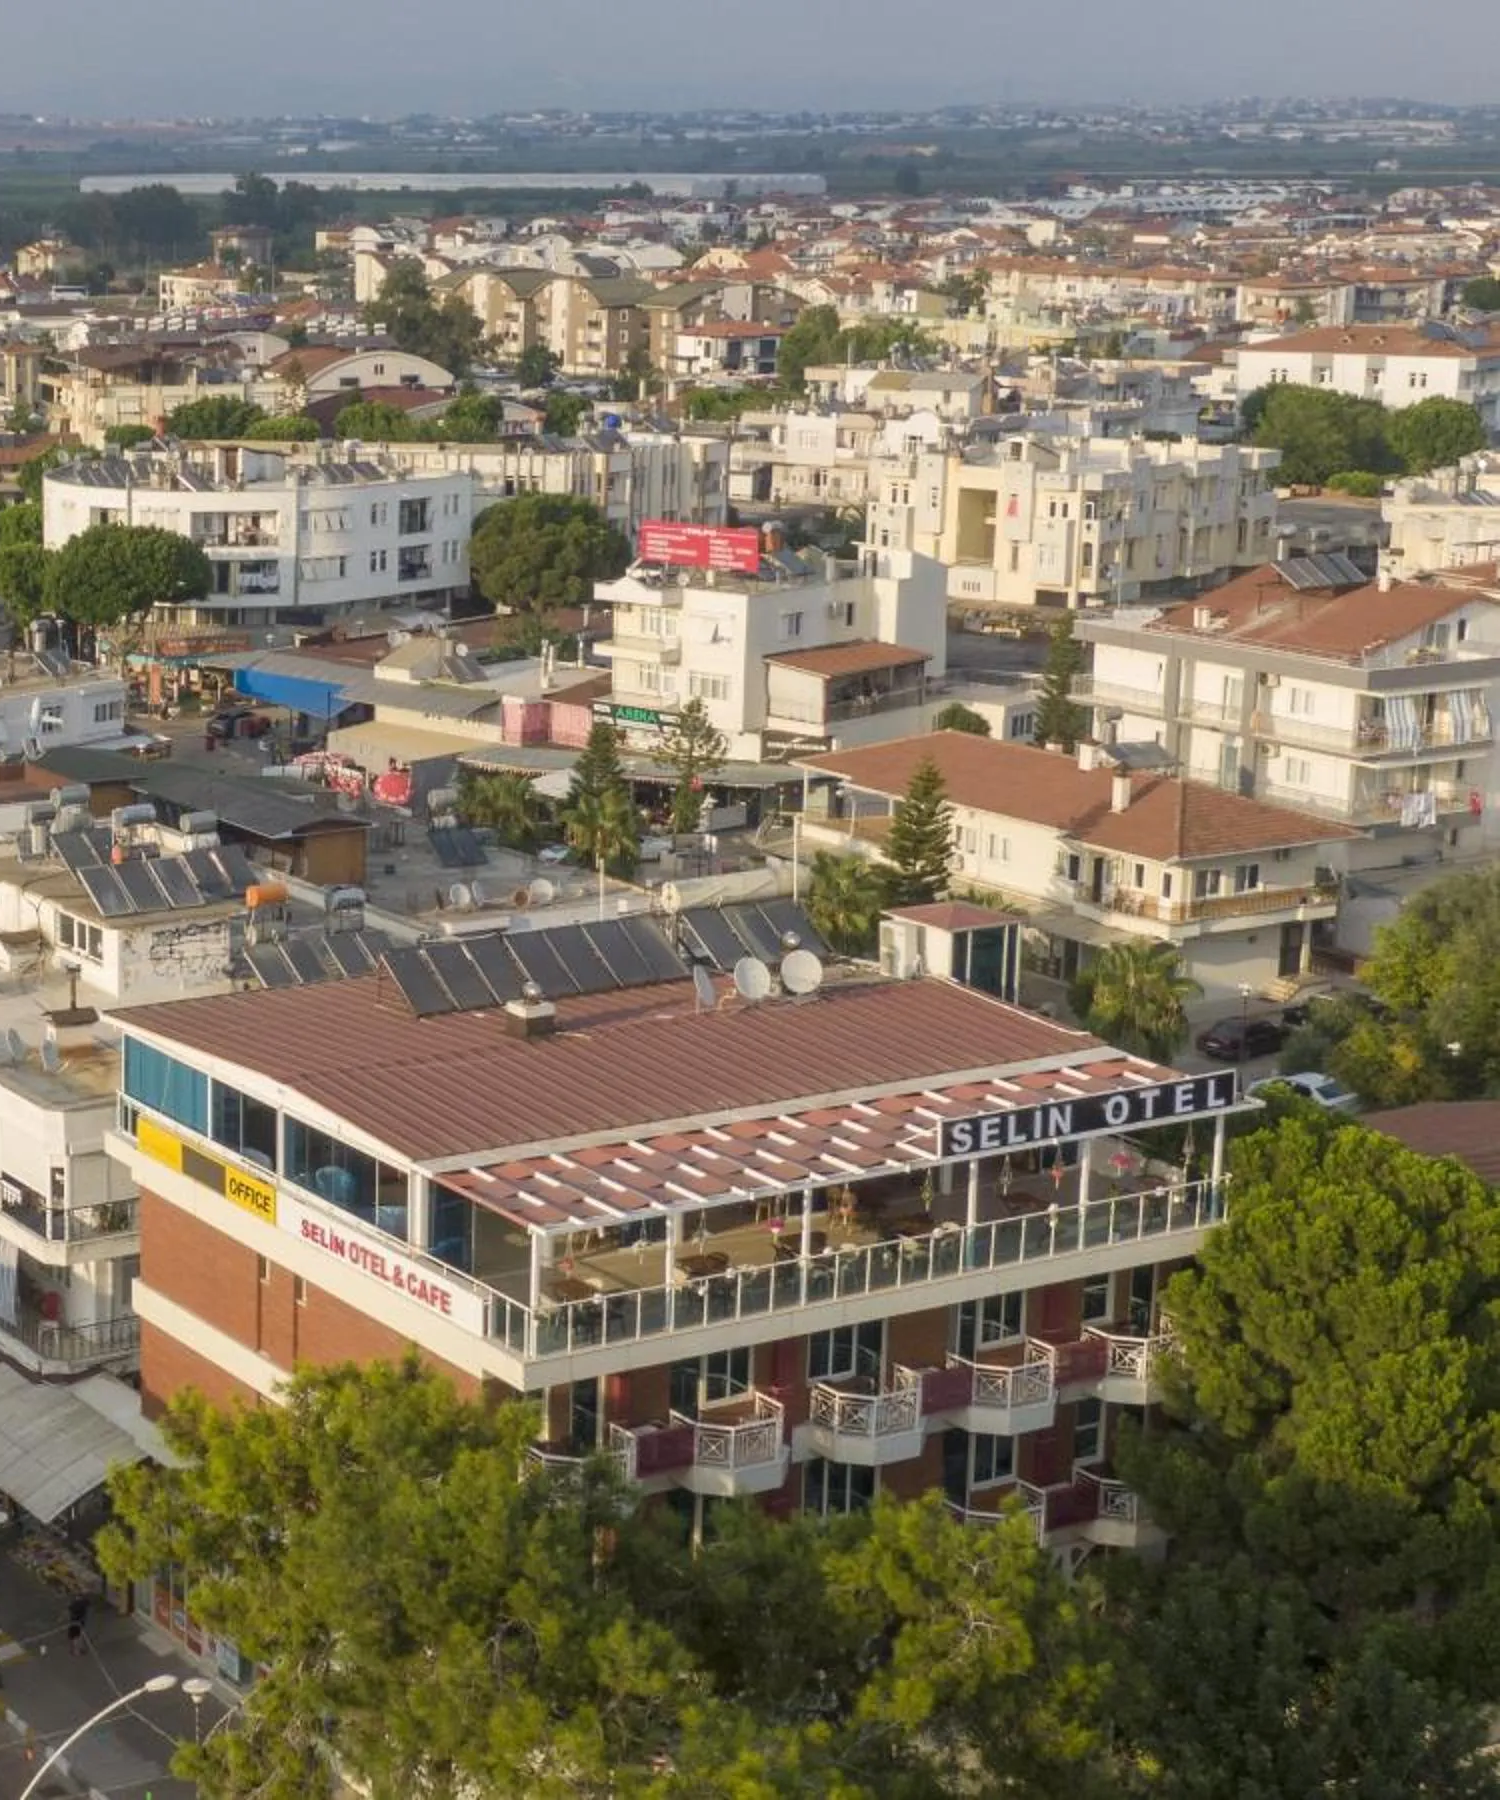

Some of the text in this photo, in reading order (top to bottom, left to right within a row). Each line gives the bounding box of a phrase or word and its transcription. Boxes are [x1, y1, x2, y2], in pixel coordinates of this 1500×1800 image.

[1105, 1079, 1225, 1125] OTEL
[229, 1178, 271, 1212] OFFICE
[349, 1243, 390, 1281] OTEL
[407, 1273, 452, 1313] CAFE
